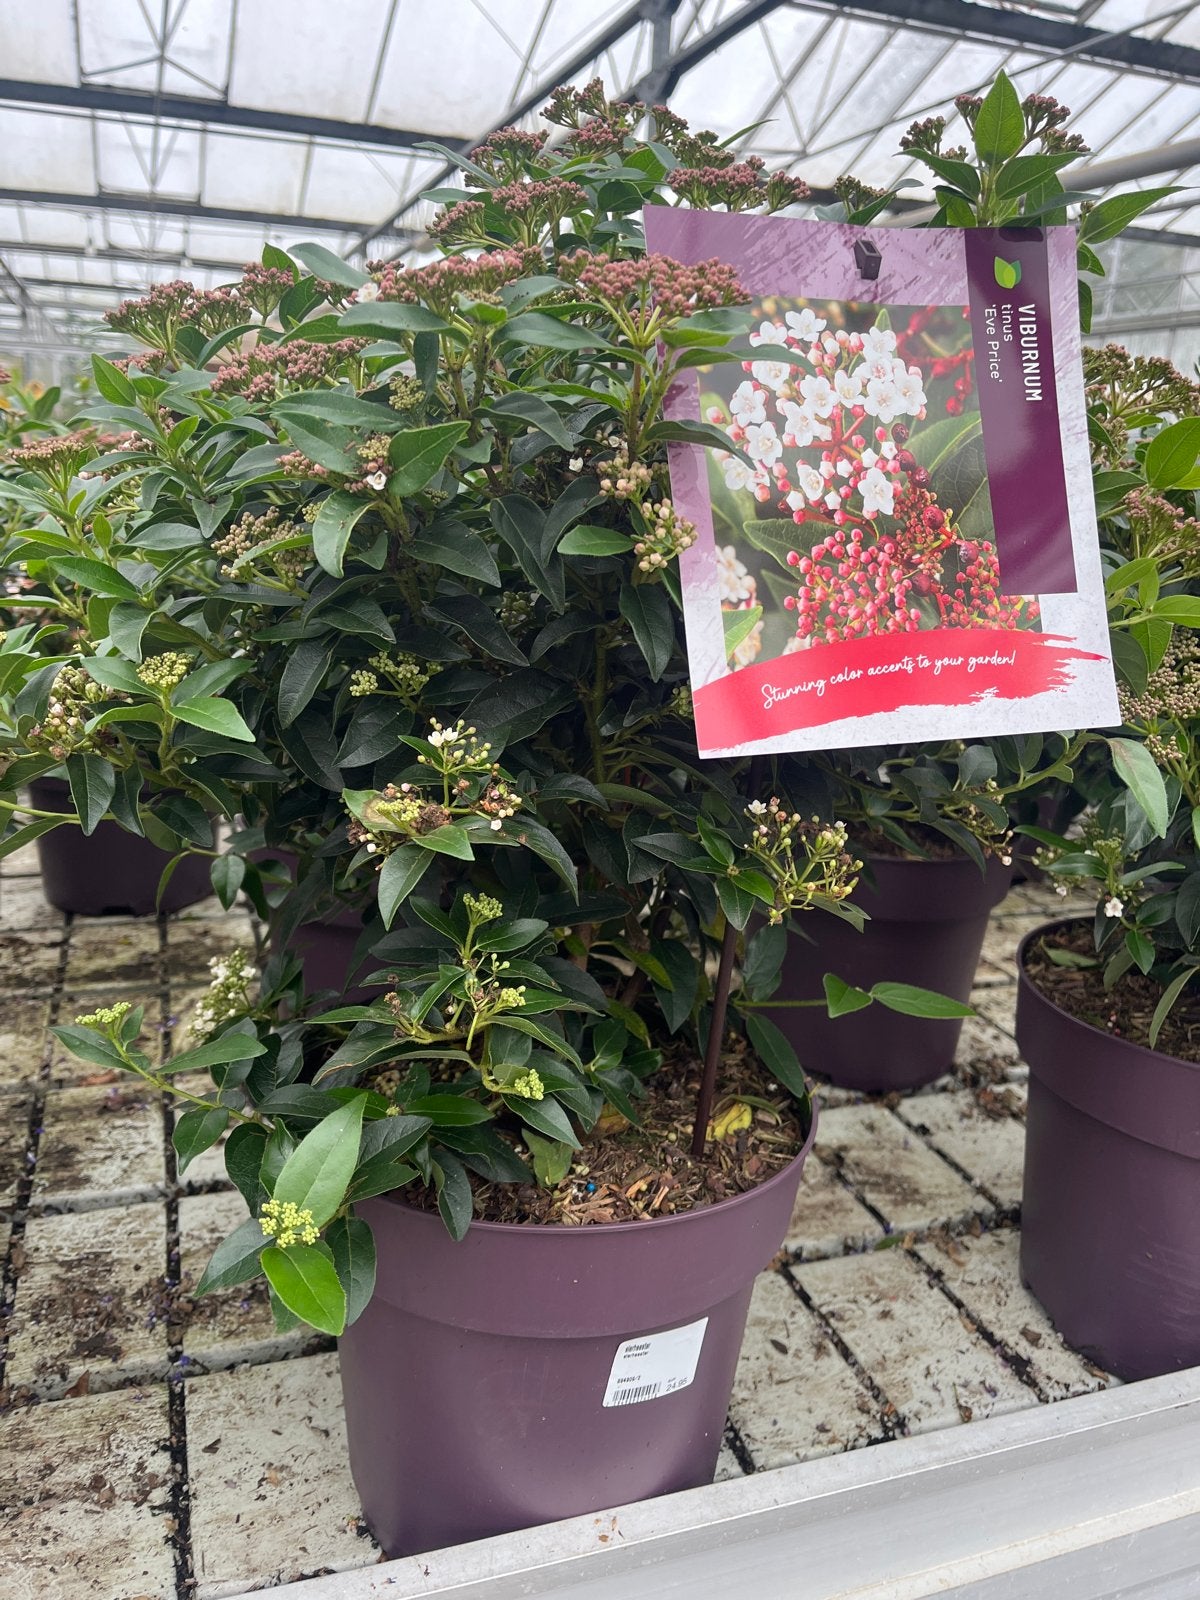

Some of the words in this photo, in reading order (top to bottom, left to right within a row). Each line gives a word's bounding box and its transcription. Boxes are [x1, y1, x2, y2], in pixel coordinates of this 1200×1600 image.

[985, 304, 997, 335] 'Eve
[1001, 303, 1014, 342] tinus
[987, 341, 1003, 383] Price'
[1018, 303, 1043, 401] VIBURNUM
[761, 679, 827, 710] Stunning
[830, 666, 864, 685] color
[867, 655, 916, 675] accents
[915, 653, 932, 668] to
[933, 656, 965, 676] your
[967, 650, 1016, 672] garden!
